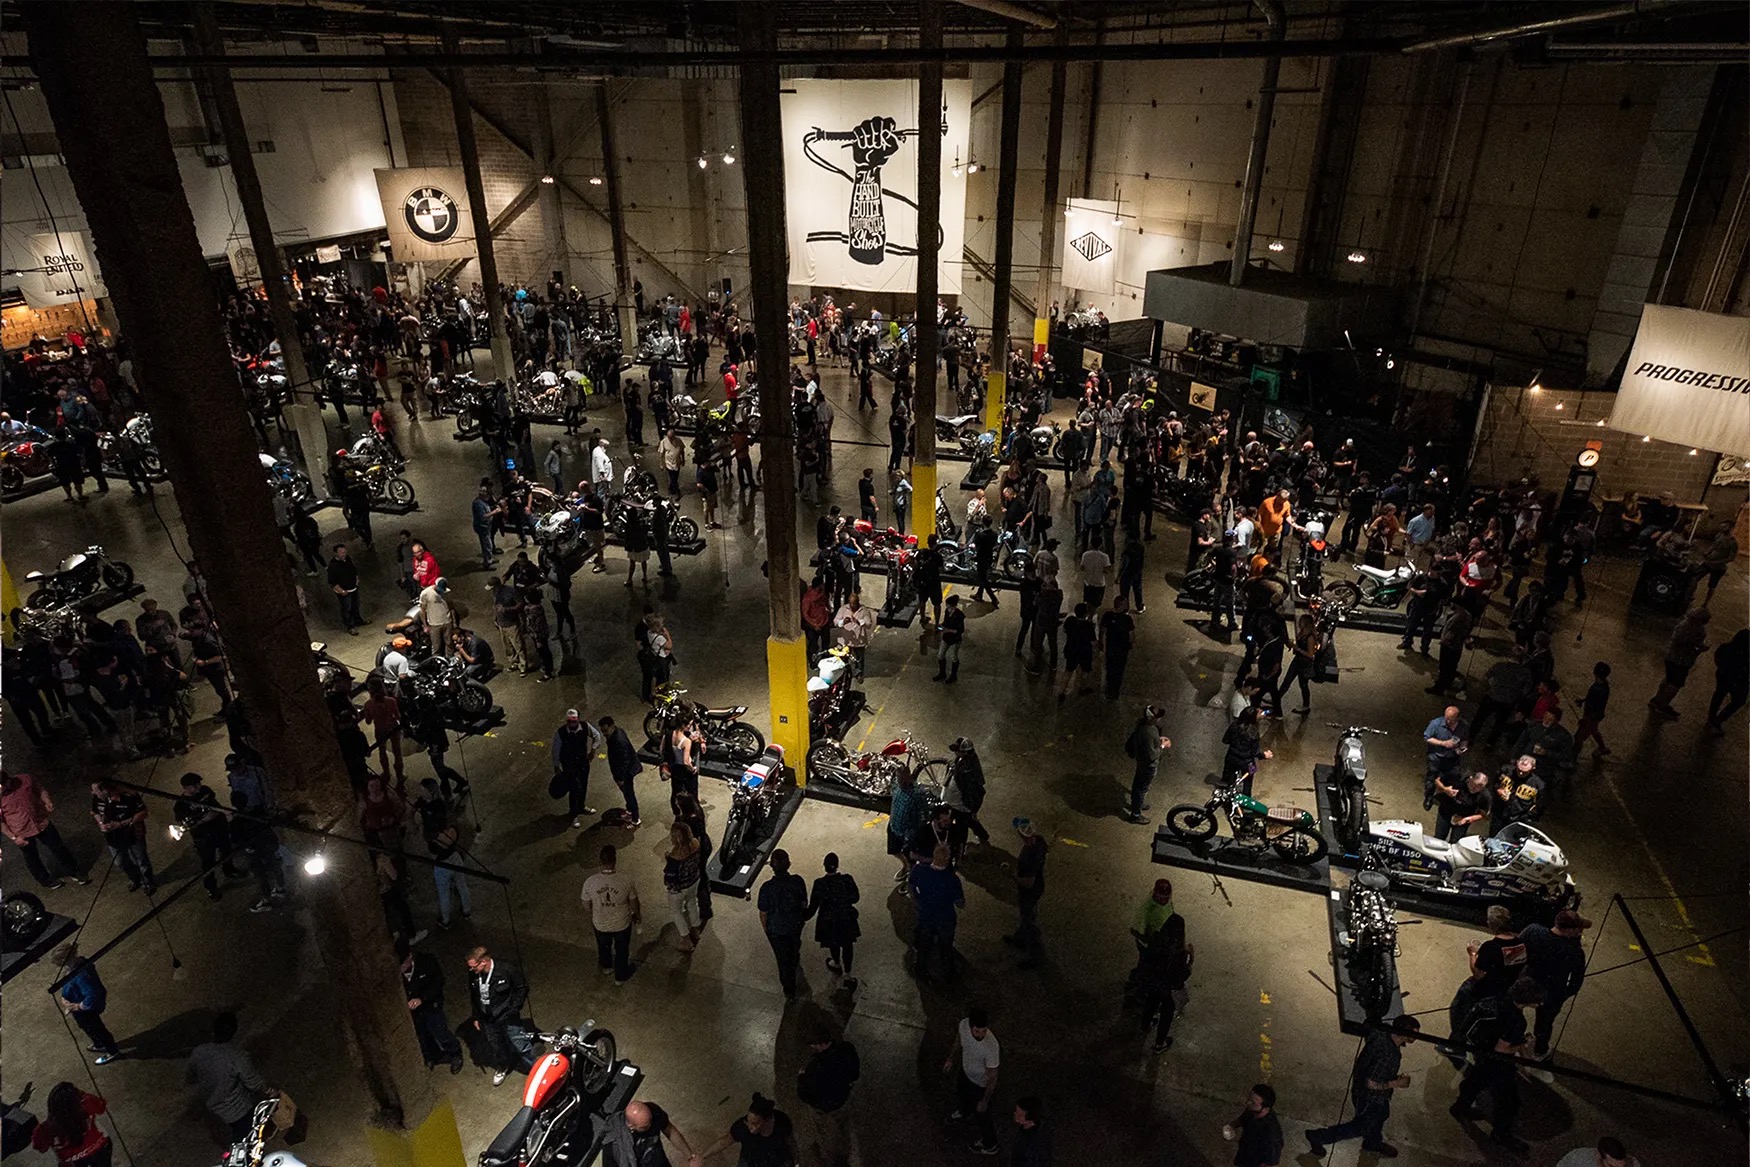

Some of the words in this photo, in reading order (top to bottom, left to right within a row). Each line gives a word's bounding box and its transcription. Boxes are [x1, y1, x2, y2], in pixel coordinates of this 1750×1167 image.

[406, 188, 452, 209] BMW
[854, 183, 880, 200] HAND
[852, 200, 880, 217] BUILT
[44, 254, 78, 266] ROYAL
[1402, 849, 1422, 859] 1350
